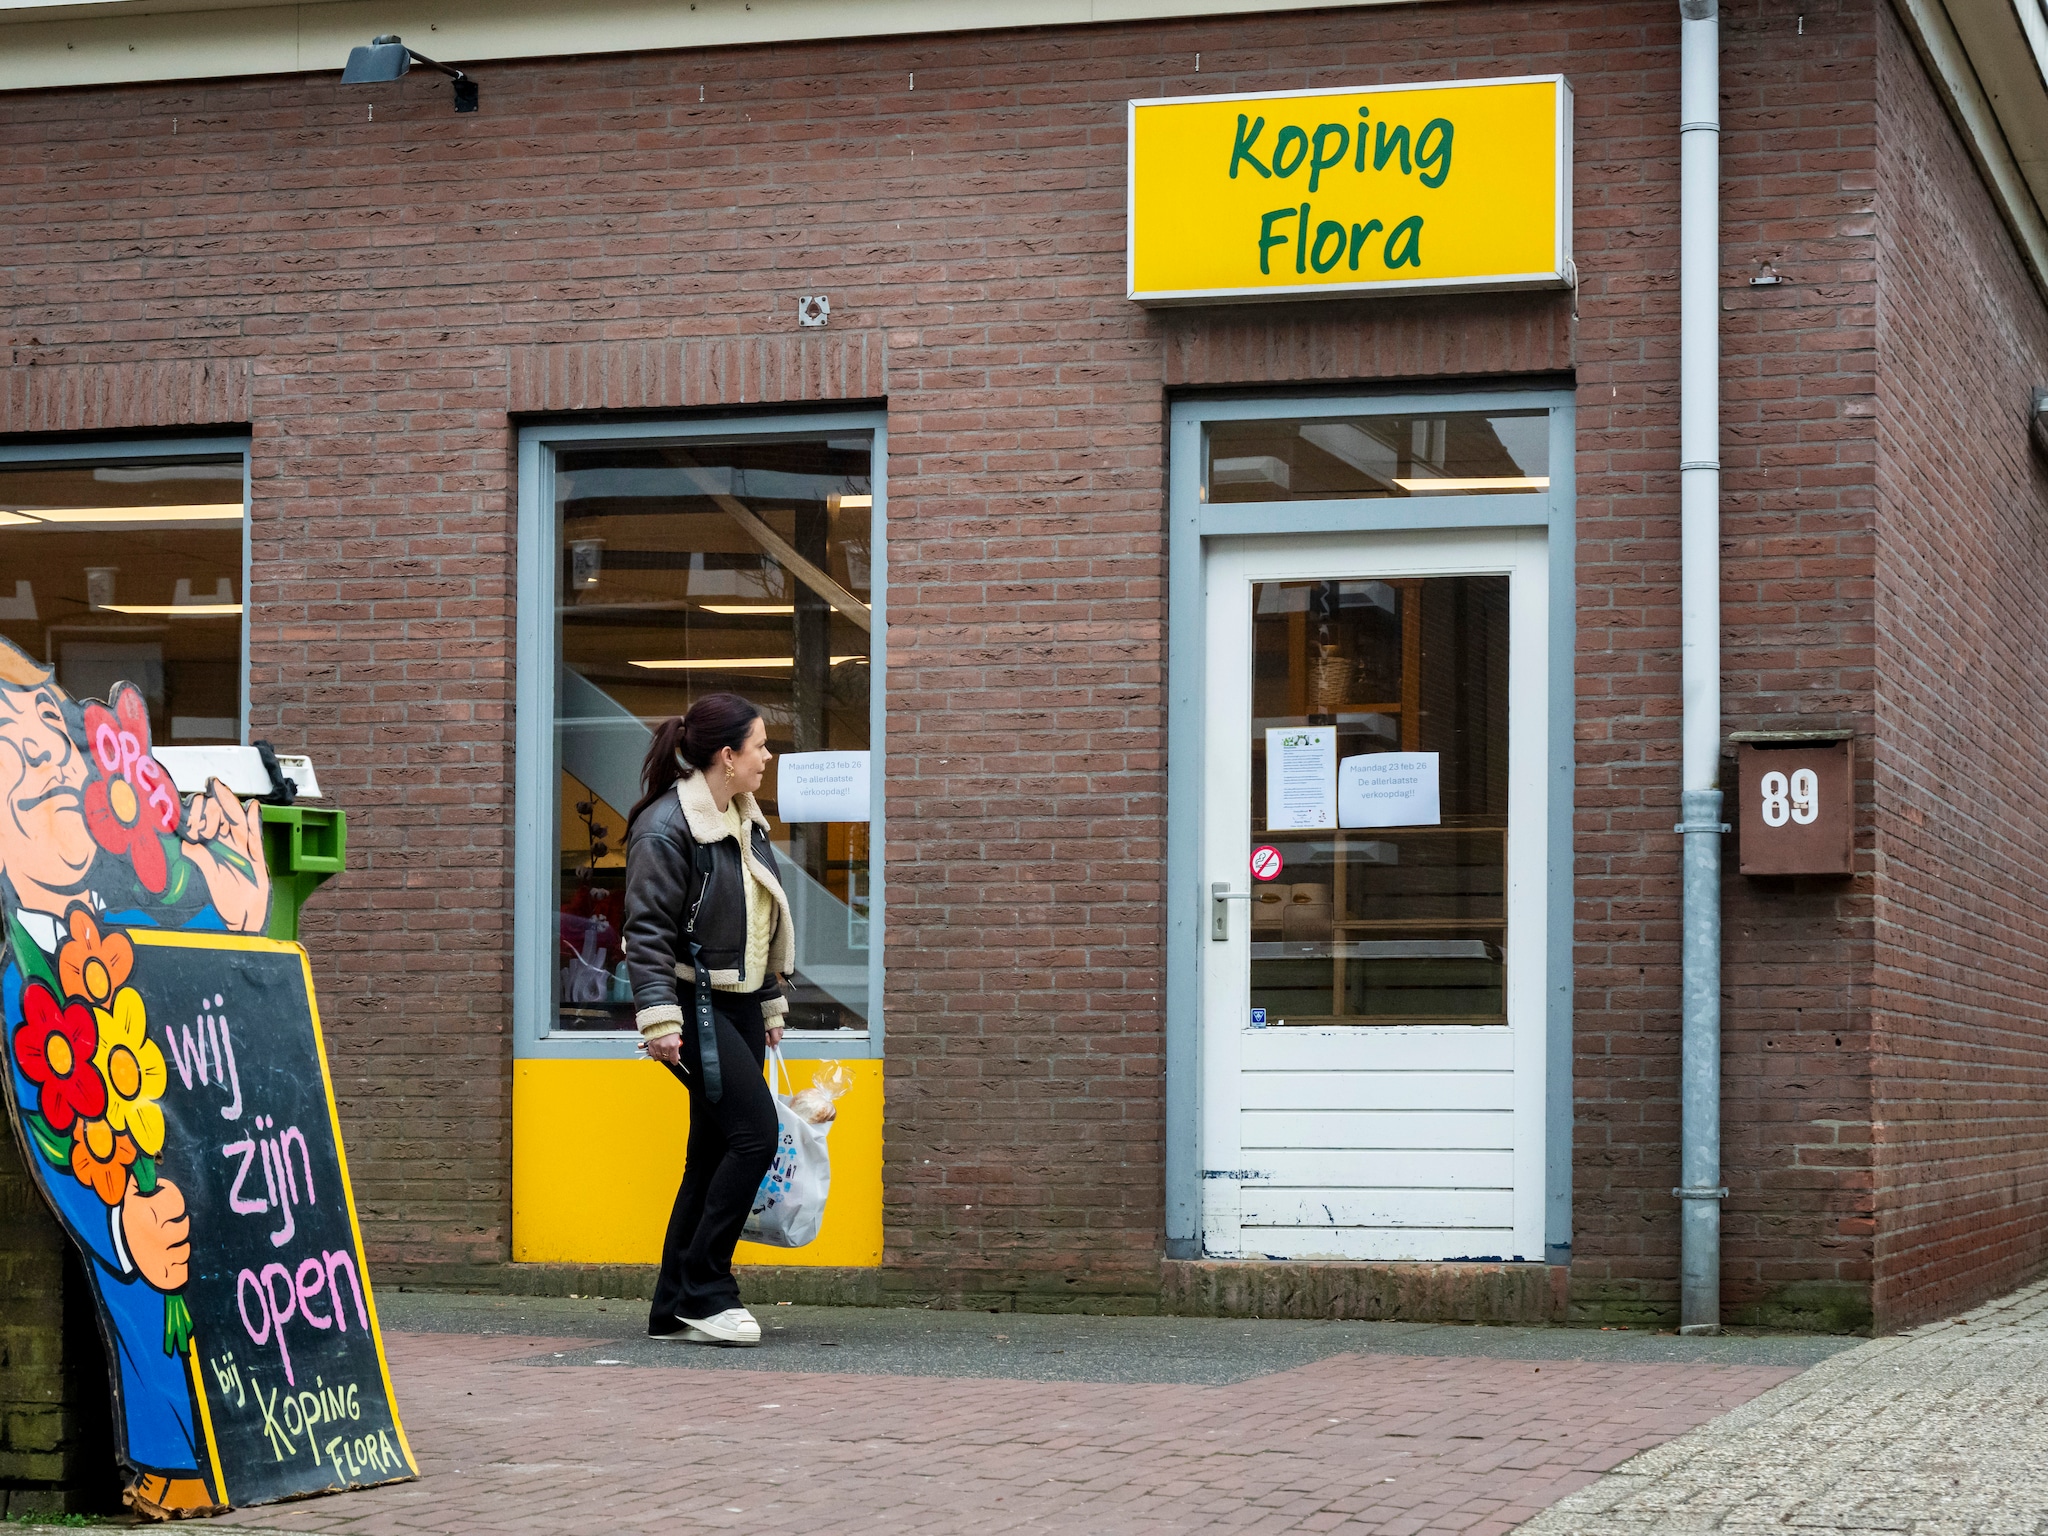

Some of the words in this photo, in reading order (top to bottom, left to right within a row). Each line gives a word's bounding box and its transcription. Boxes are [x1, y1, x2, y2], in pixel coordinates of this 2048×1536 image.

[1229, 106, 1454, 193] Koping
[1258, 202, 1425, 275] Flora
[788, 762, 824, 771] Maandag
[825, 761, 836, 770] 23
[837, 760, 850, 769] feb
[851, 760, 862, 769] 26
[797, 776, 807, 784] De
[809, 775, 853, 783] allerlaatste
[800, 787, 850, 796] verkoopdag!!
[1350, 763, 1387, 773] Maandag
[1388, 762, 1399, 771] 23
[1401, 762, 1415, 771] feb
[1416, 761, 1427, 770] 26
[1358, 778, 1370, 787] De
[1371, 777, 1418, 786] allerlaatste
[1361, 789, 1415, 799] verkoopdag!!
[1760, 768, 1819, 828] 89
[222, 1114, 317, 1248] zijn
[236, 1250, 369, 1387] open
[210, 1351, 245, 1408] bij
[325, 1429, 403, 1485] FLORA
